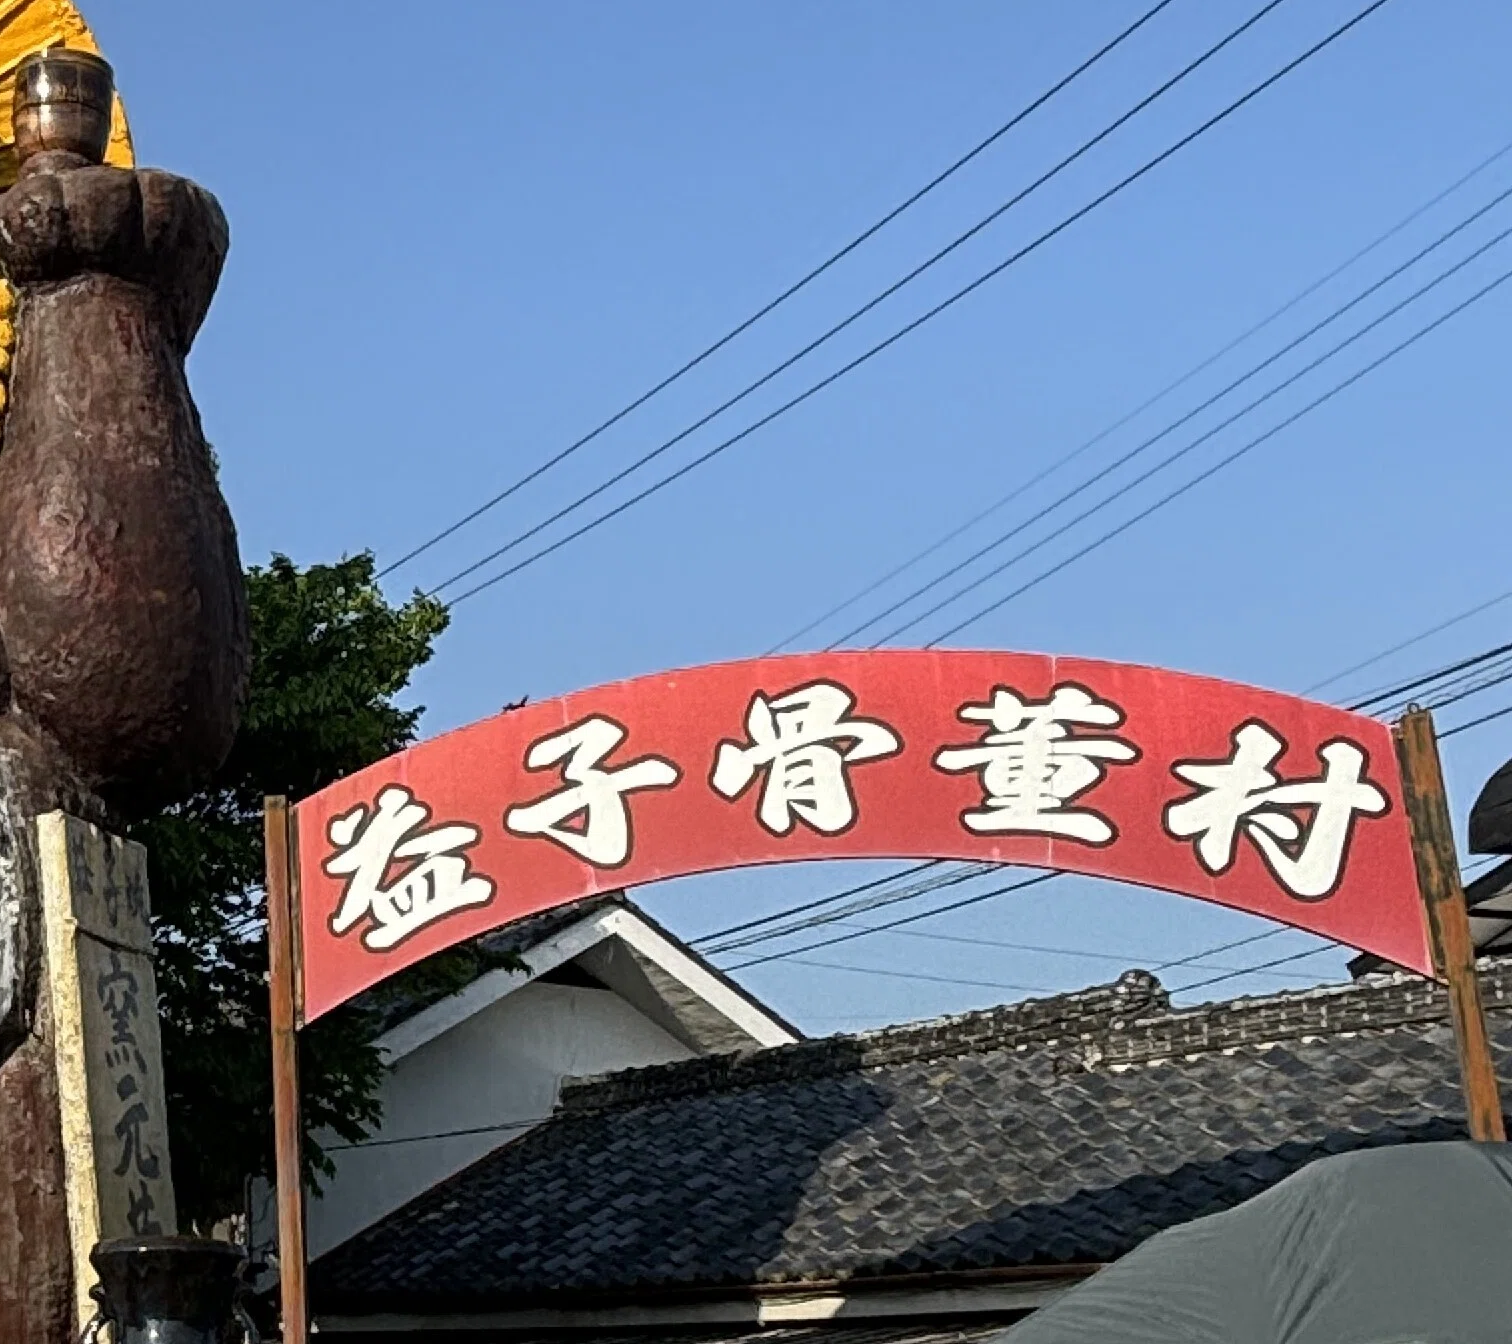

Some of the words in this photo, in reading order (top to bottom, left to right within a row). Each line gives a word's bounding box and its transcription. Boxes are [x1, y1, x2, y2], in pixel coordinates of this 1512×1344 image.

[325, 678, 1389, 953] 益子骨董村
